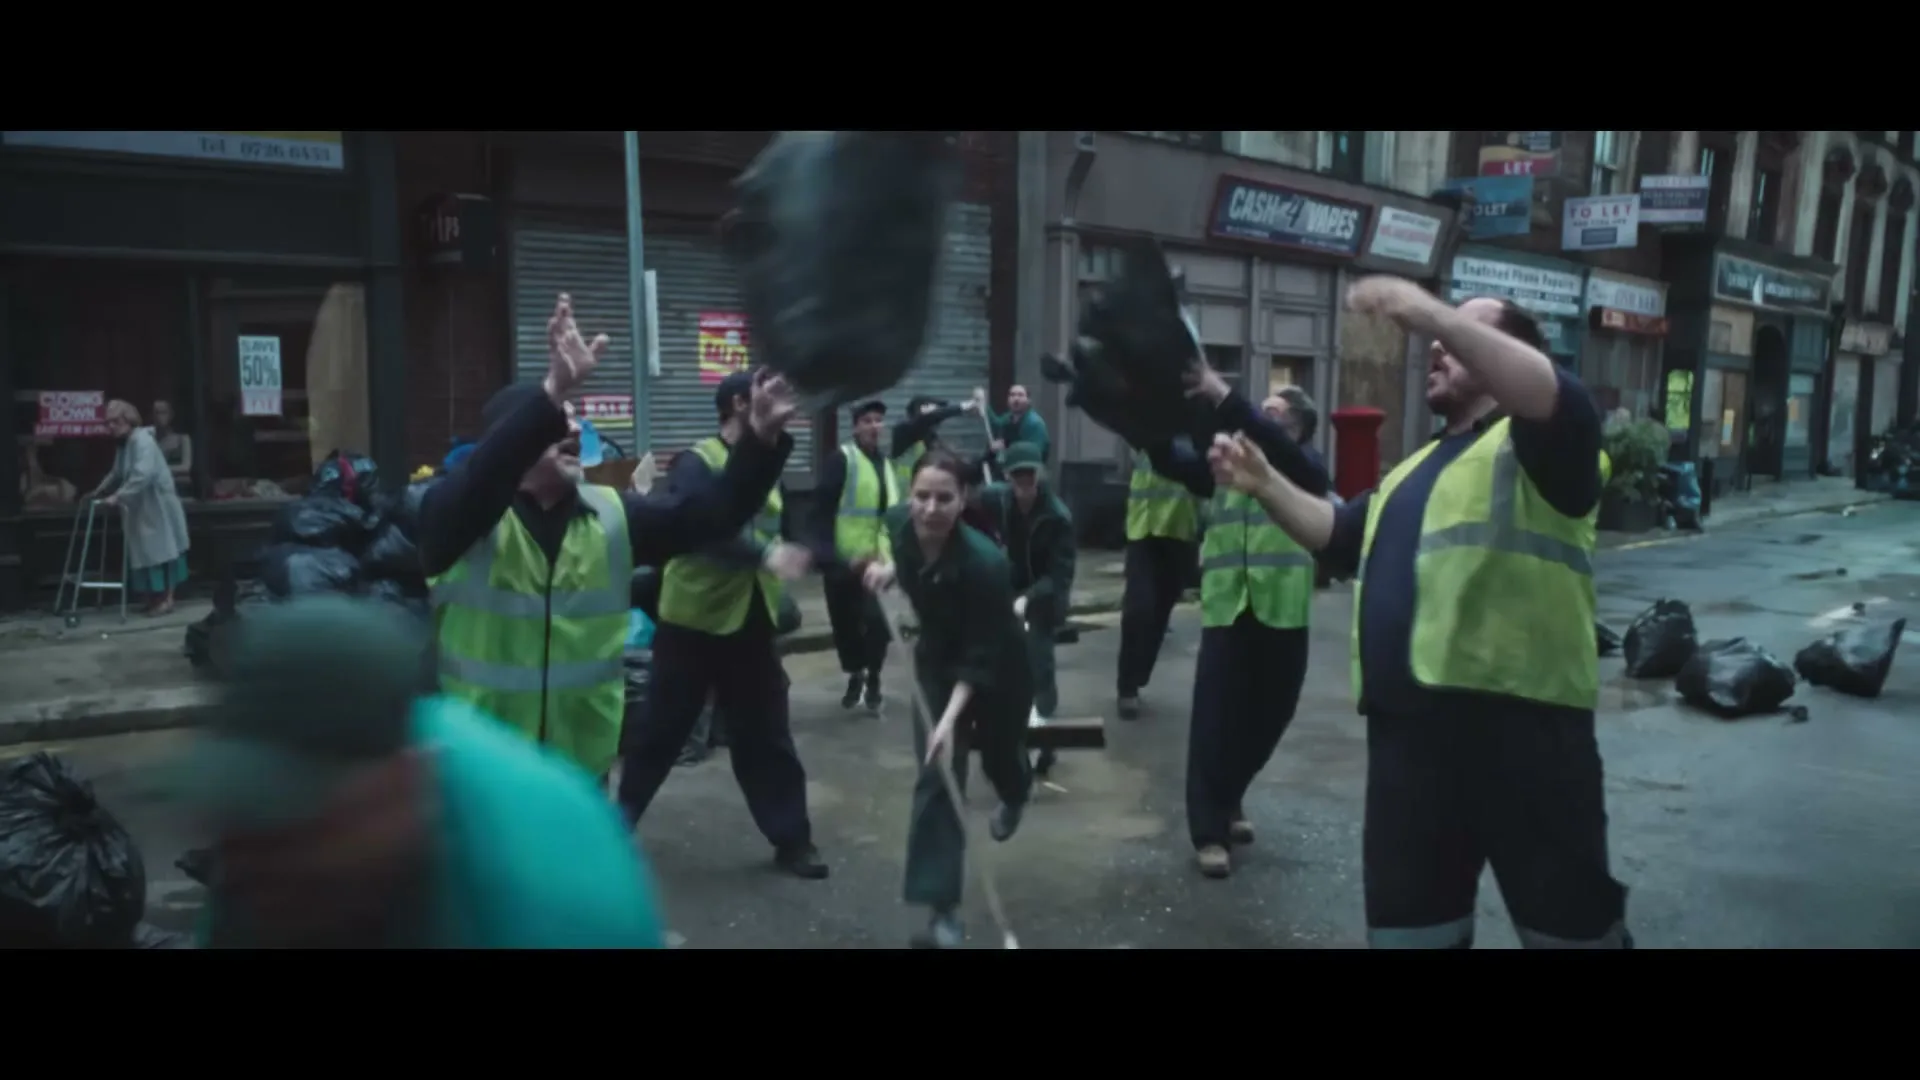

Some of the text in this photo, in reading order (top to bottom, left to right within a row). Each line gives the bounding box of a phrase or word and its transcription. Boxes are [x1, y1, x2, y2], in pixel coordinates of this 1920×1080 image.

[1503, 161, 1532, 175] LET
[1229, 186, 1280, 225] CASH
[1286, 195, 1305, 229] 4
[1305, 199, 1358, 240] VAPES
[1485, 202, 1508, 216] LET
[1569, 204, 1632, 219] TO LET
[1512, 267, 1540, 285] Phone
[242, 355, 279, 387] 50%
[40, 391, 103, 407] CLOSING
[50, 407, 95, 421] DOWN
